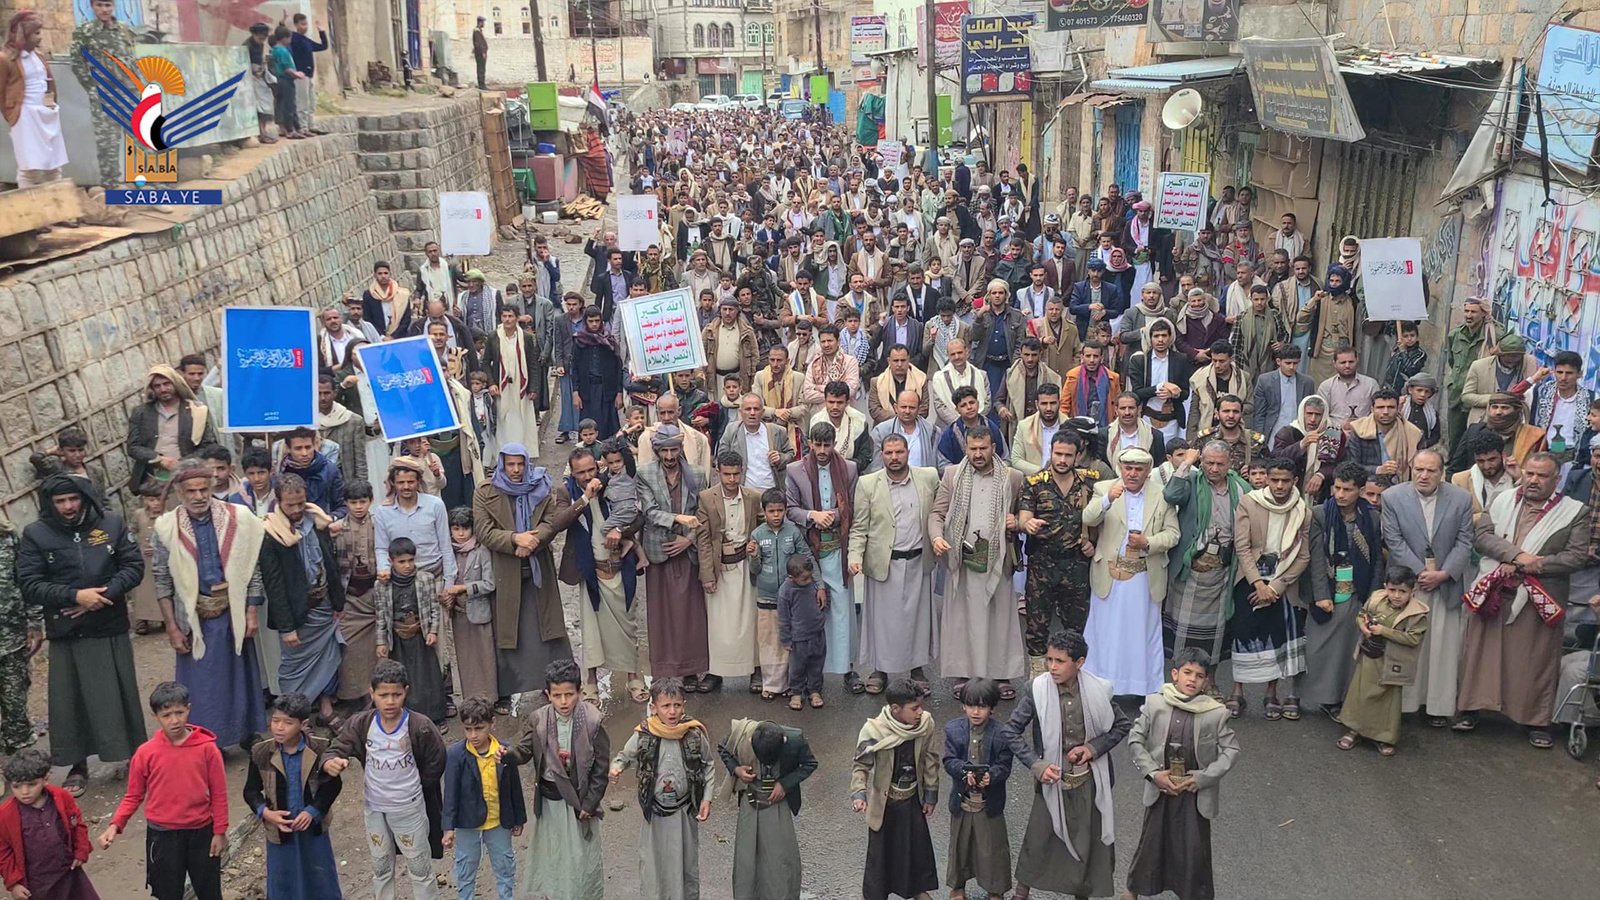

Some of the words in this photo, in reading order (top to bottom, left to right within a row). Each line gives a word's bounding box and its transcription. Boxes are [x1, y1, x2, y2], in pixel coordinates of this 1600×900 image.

[966, 18, 1003, 34] الملك
[1007, 20, 1032, 34] عبد
[1076, 17, 1098, 25] 401573
[1188, 180, 1203, 188] الله
[667, 300, 683, 312] الله
[665, 314, 685, 325] الموت
[668, 326, 687, 338] الموت
[673, 349, 692, 364] النصر
